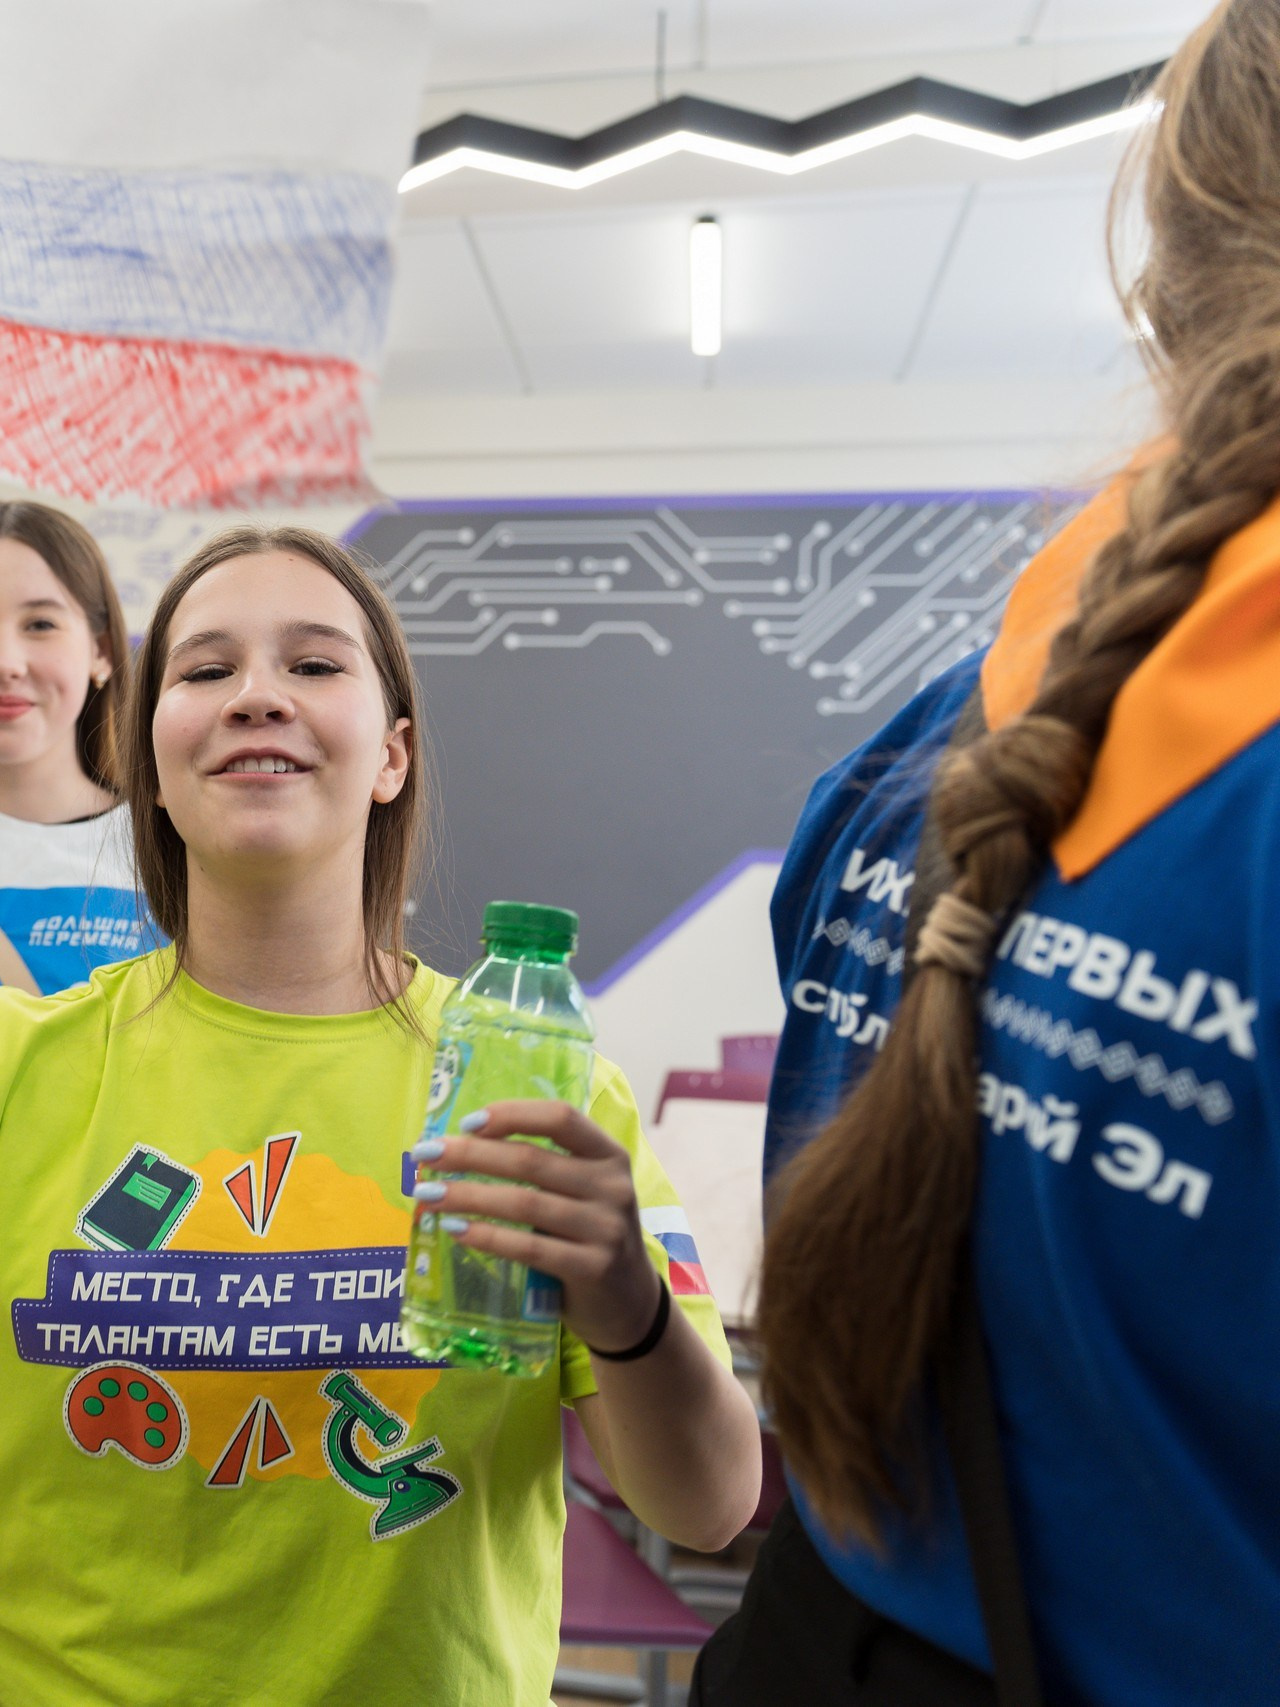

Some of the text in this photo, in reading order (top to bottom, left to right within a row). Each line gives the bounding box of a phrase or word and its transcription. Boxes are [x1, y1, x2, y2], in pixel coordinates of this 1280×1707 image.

[996, 910, 1260, 1062] ПЕРВЫХ
[1091, 1122, 1214, 1221] Эл
[71, 1268, 408, 1308] МЕСТО, ГДЕ ТВОИ
[36, 1322, 410, 1356] ТАЛАНТАМ ЕСТЬ МЕ
